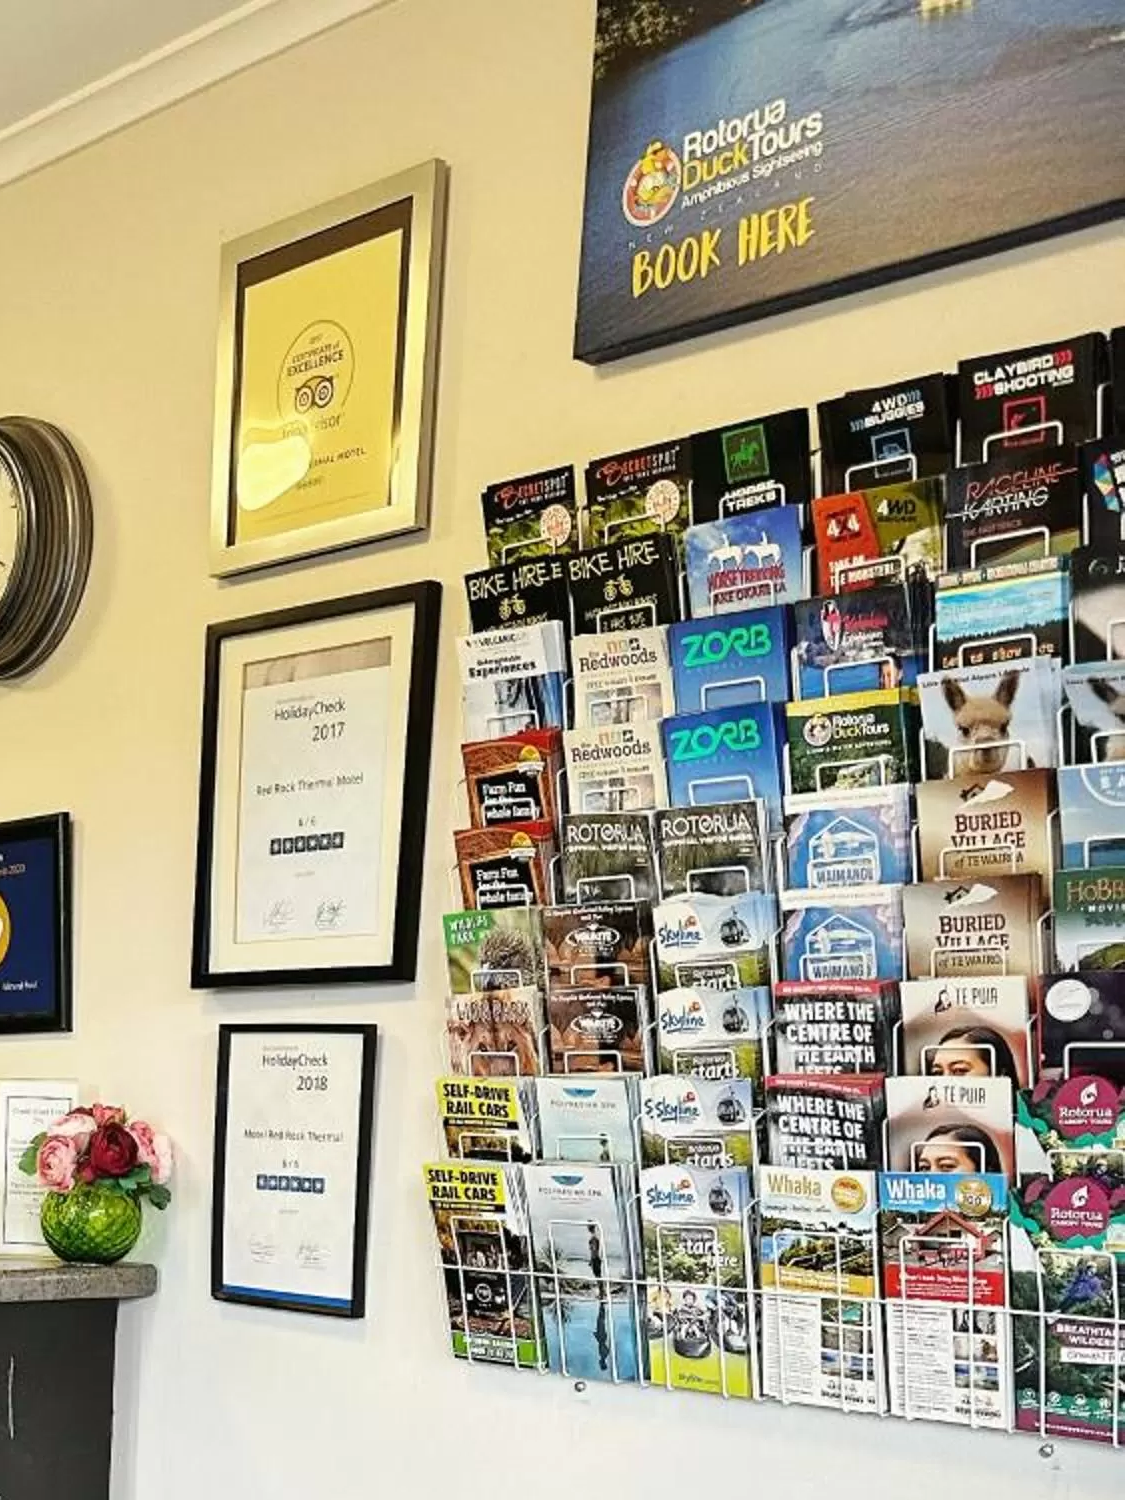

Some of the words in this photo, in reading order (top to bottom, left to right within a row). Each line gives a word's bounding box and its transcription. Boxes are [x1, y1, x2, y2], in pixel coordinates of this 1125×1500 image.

[683, 98, 786, 161] Rotorua
[681, 171, 751, 211] Amphibious
[751, 139, 824, 184] Sightseeing
[632, 226, 722, 300] BOOK
[738, 196, 816, 267] HERE
[287, 350, 344, 377] EXCELLENCE
[973, 352, 1054, 386] CLAYBIRD
[993, 364, 1074, 396] SHOOTING
[864, 400, 925, 429] BUGGIES
[569, 551, 613, 580] BIKE
[618, 540, 659, 568] HIRE
[469, 573, 509, 601] BIKE
[512, 564, 552, 589] HIRE
[681, 623, 772, 669] ZORB
[468, 661, 536, 679] Experiences
[578, 648, 658, 673] Redwoods
[274, 696, 346, 722] HolidayCheck
[312, 721, 346, 743] 2017
[832, 712, 875, 731] Rotorua
[571, 740, 652, 763] Redwoods
[671, 719, 762, 761] ZORB
[508, 781, 527, 793] Fun
[566, 822, 646, 844] ROTORUA
[660, 811, 752, 839] ROTORUA
[954, 810, 1022, 834] BURIED
[951, 831, 1026, 850] VILLAGE
[658, 919, 703, 948] Skyline
[939, 913, 1006, 935] BURIED
[935, 933, 1010, 951] VILLAGE
[956, 987, 970, 1006] TE
[972, 986, 997, 1006] PUIA
[660, 1004, 706, 1034] Skyline
[784, 1001, 843, 1023] WHERE
[846, 1003, 875, 1021] THE
[785, 1023, 852, 1043] CENTRE
[854, 1025, 873, 1043] OF
[262, 1052, 328, 1071] HolidayCheck
[296, 1075, 328, 1092] 2018
[442, 1083, 511, 1102] SELF-DRIVE
[940, 1085, 956, 1105] TE
[958, 1086, 986, 1105] PUIA
[446, 1101, 475, 1115] RAIL
[478, 1102, 509, 1118] CARS
[655, 1096, 701, 1123] Skyline
[777, 1094, 835, 1119] WHERE
[837, 1100, 866, 1121] THE
[1059, 1106, 1113, 1118] Rotorua
[779, 1117, 841, 1138] CENTRE
[843, 1121, 863, 1140] OF
[428, 1169, 498, 1186] SELF-DRIVE
[767, 1173, 822, 1198] Whaka
[432, 1186, 461, 1200] RAIL
[464, 1187, 496, 1202] CARS
[646, 1183, 695, 1206] Skyline
[887, 1179, 946, 1200] Whaka
[1050, 1207, 1104, 1221] Rotorua
